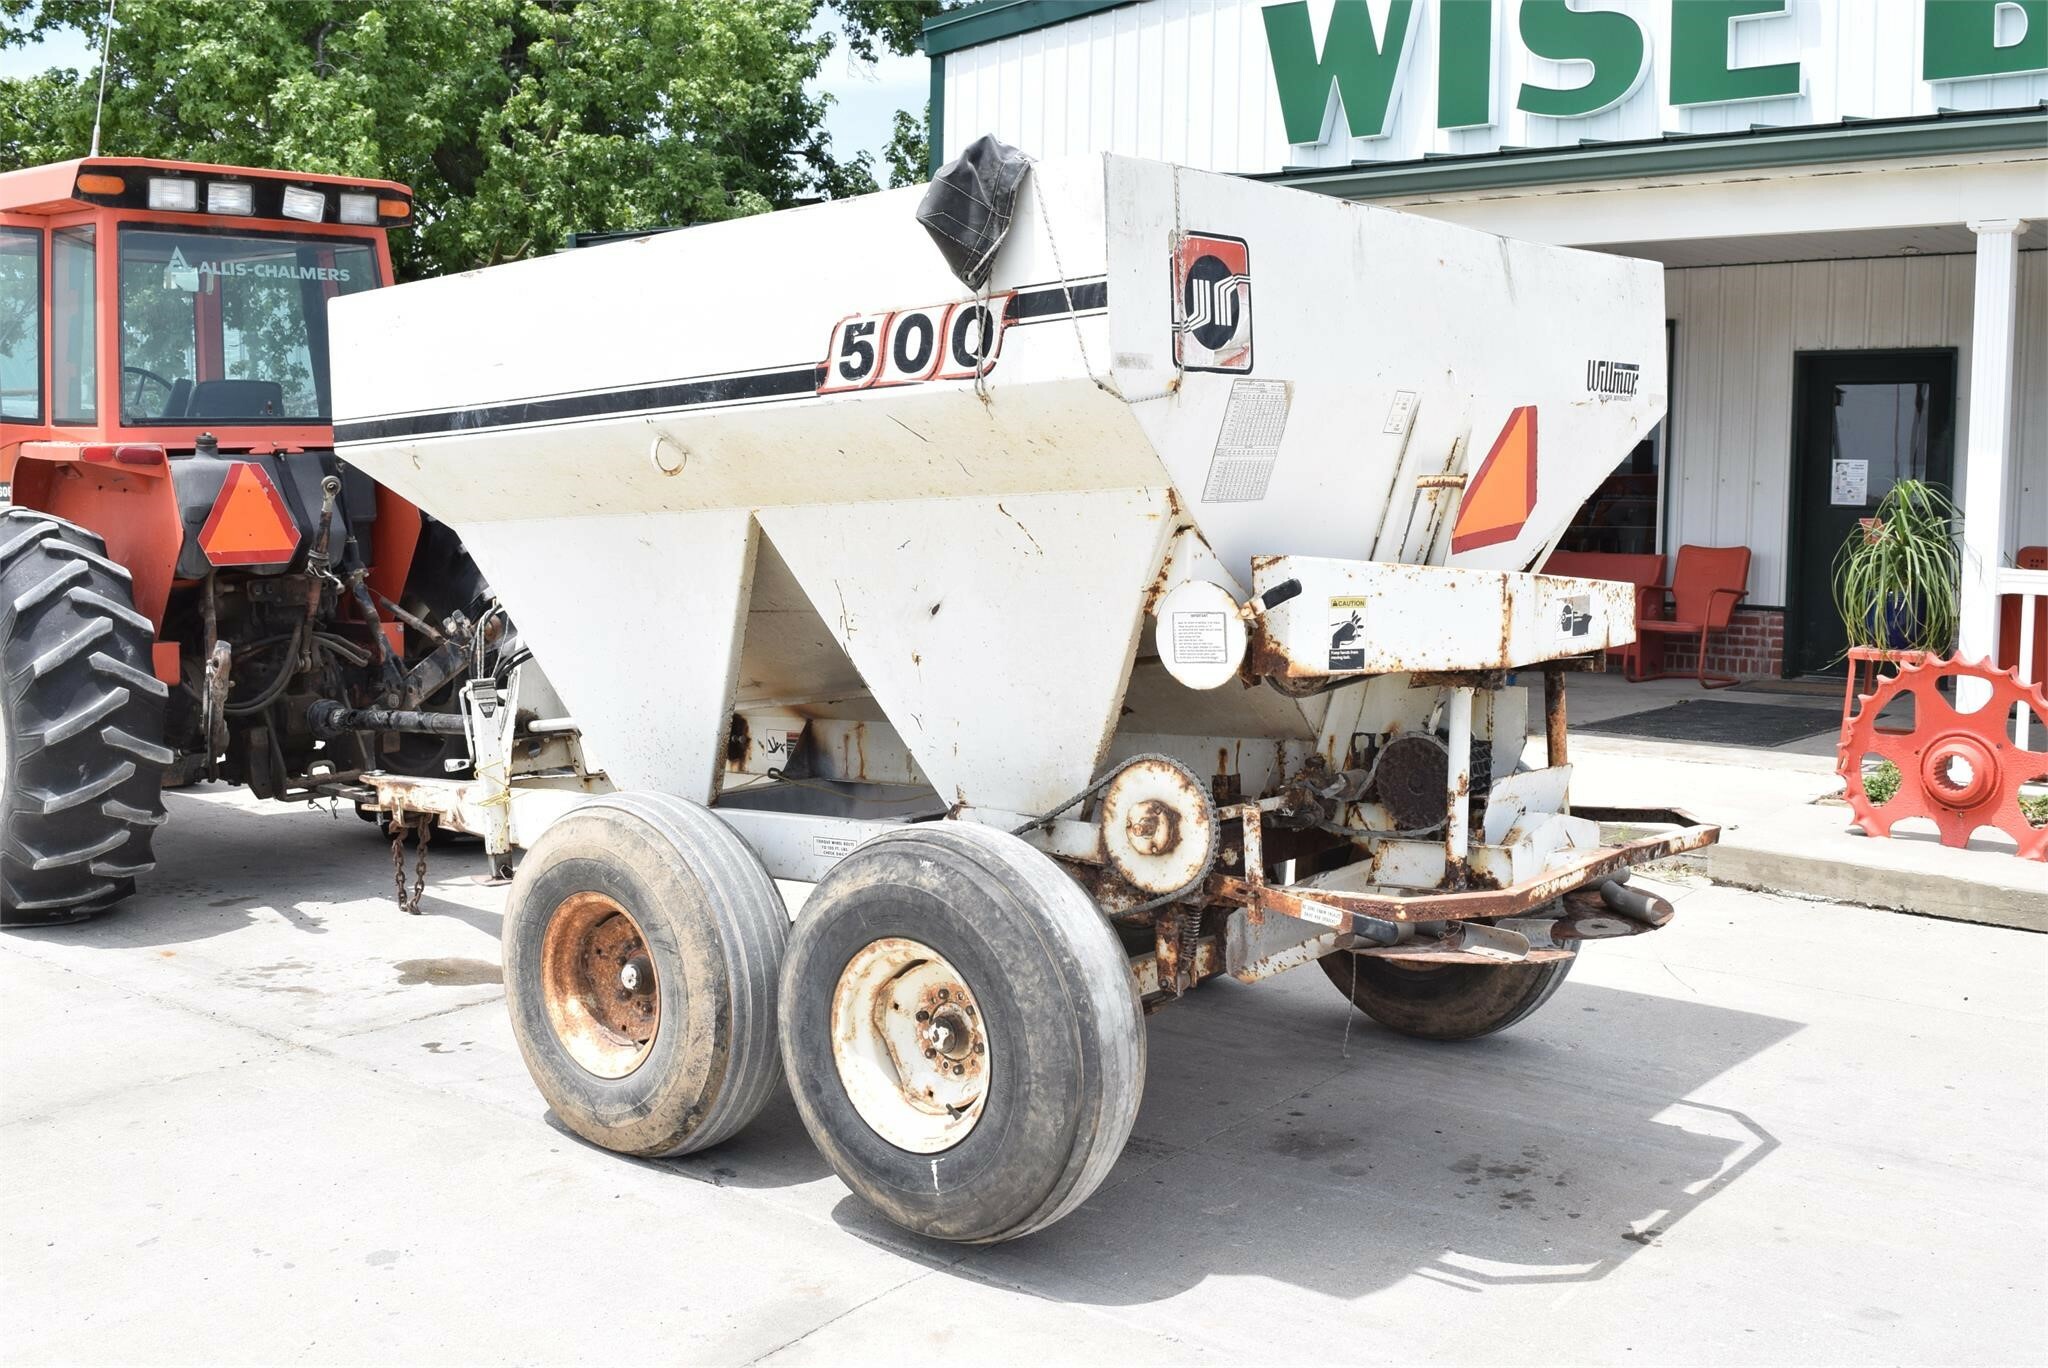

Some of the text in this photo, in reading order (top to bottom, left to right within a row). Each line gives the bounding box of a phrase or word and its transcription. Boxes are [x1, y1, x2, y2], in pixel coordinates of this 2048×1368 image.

[1261, 0, 1803, 145] WISE
[199, 260, 351, 282] ALLIS-CHALMERS
[839, 305, 994, 381] 500
